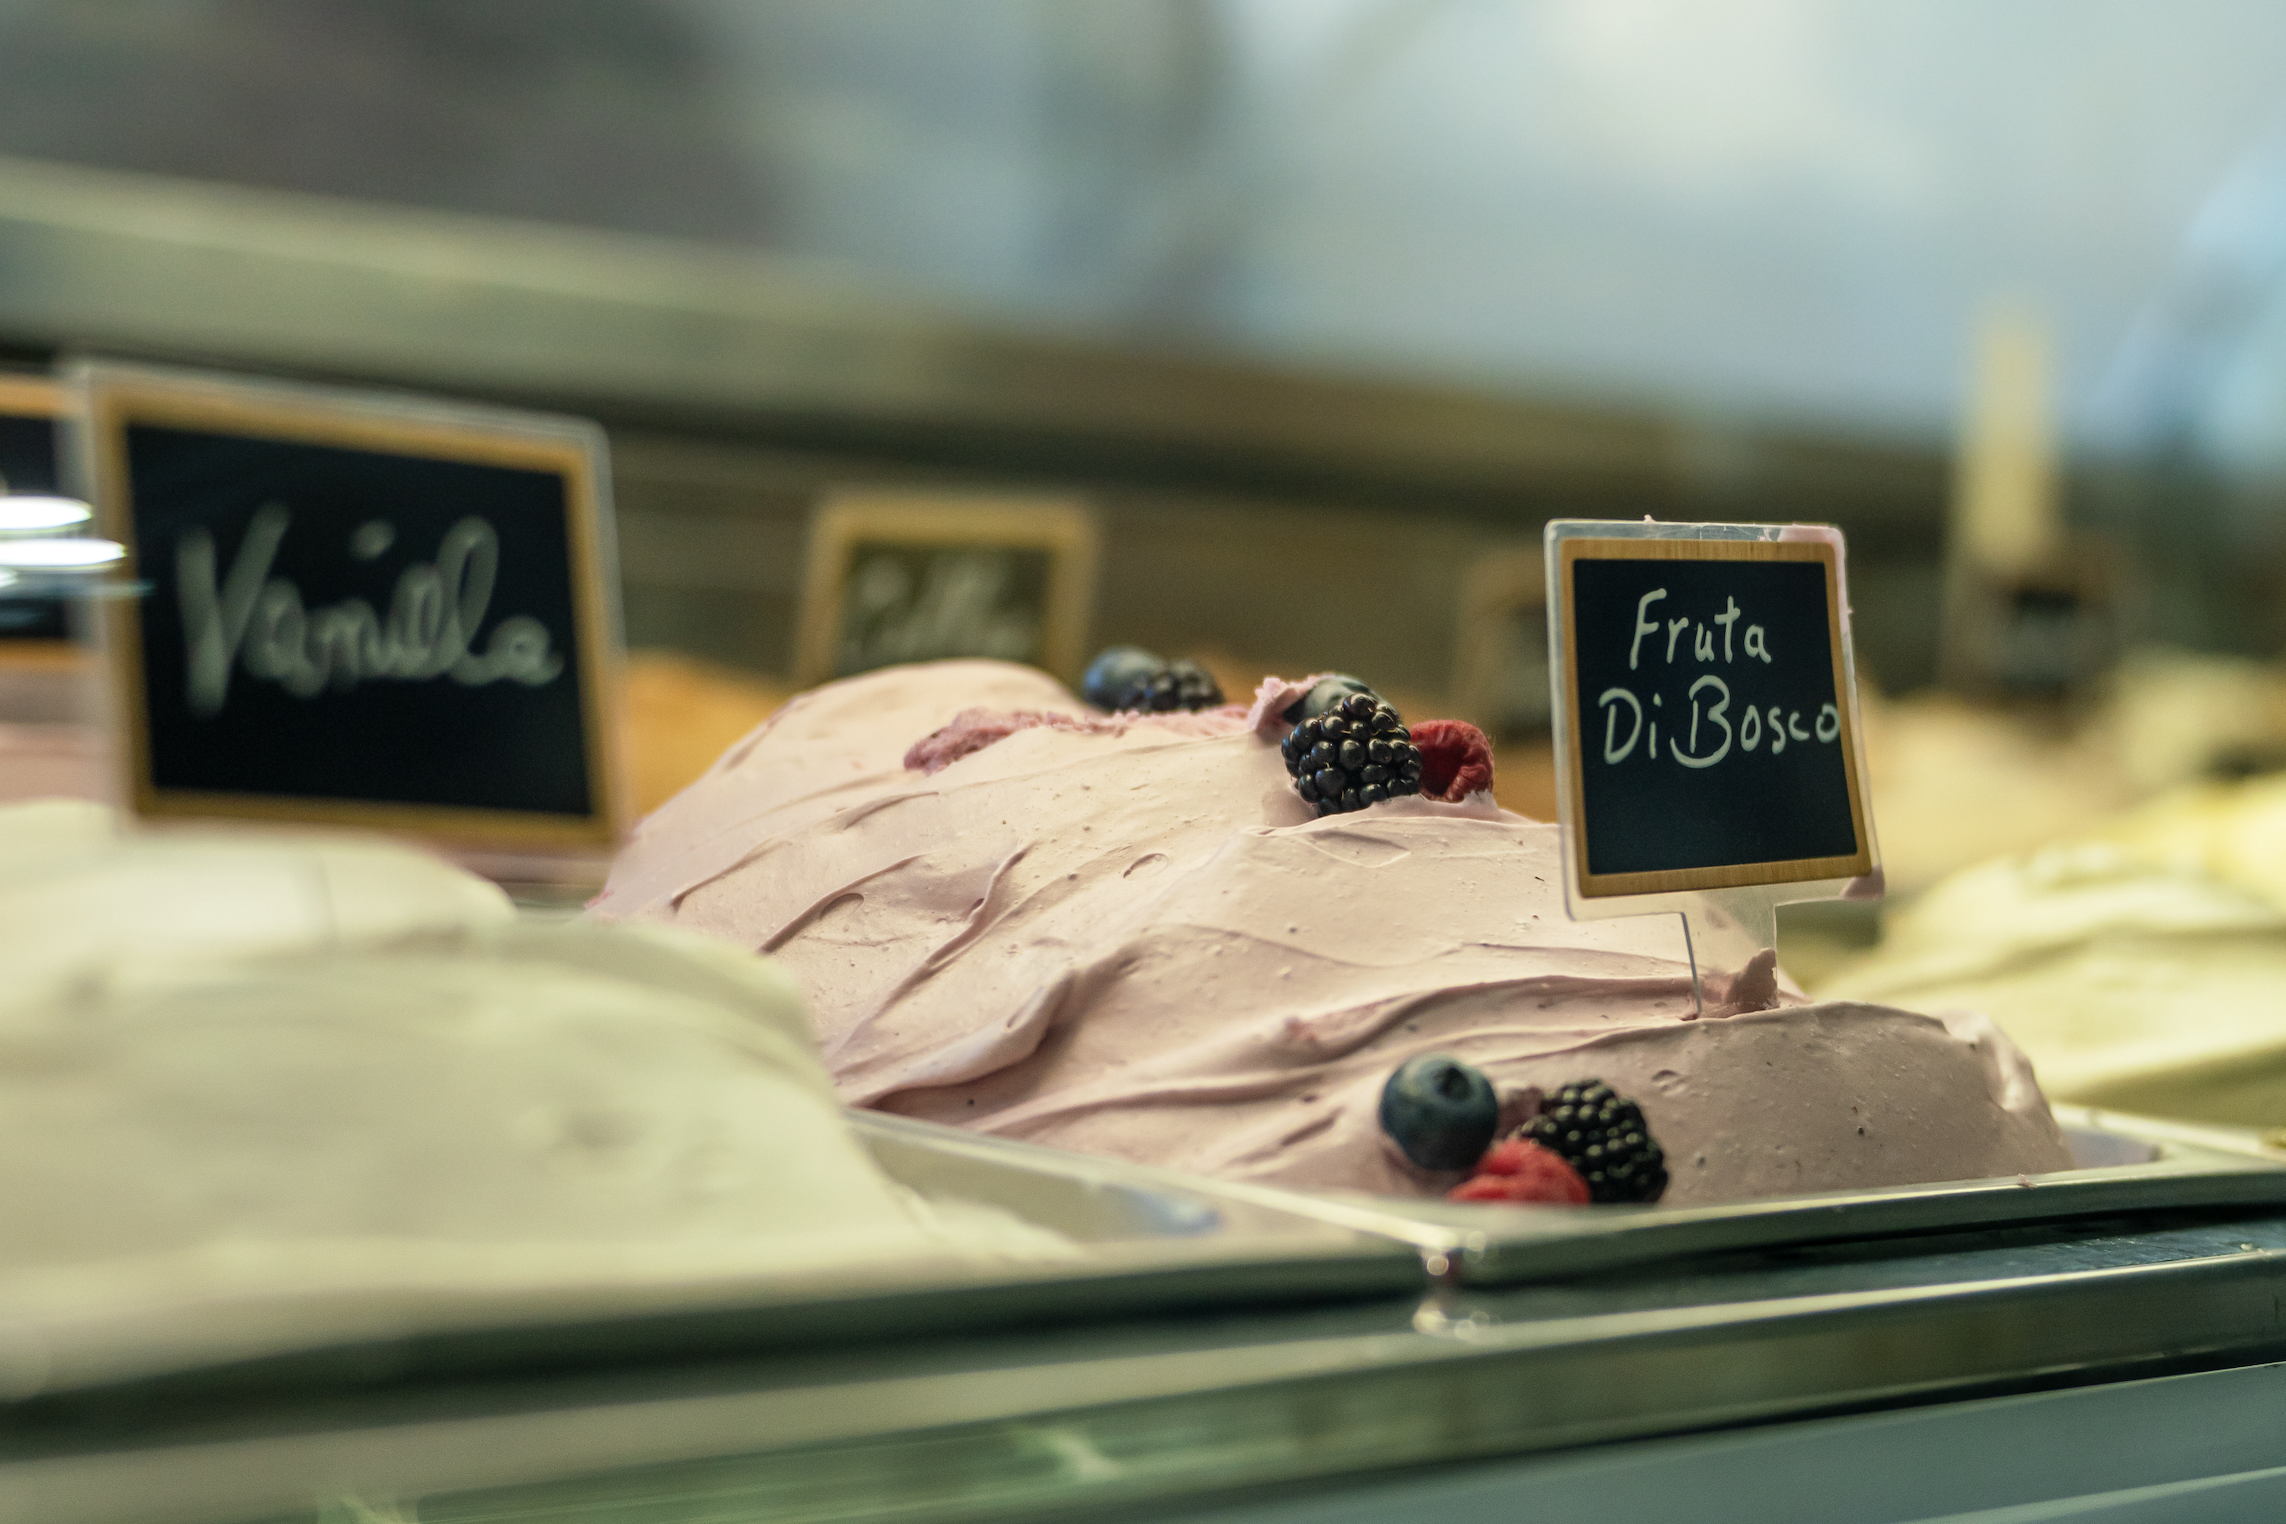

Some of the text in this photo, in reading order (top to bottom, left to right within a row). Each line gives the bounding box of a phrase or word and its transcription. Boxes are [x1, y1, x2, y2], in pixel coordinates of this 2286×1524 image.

[176, 503, 564, 717] Vanilla
[1629, 588, 1772, 670] Fruta
[1599, 675, 1841, 769] Di Bosco
